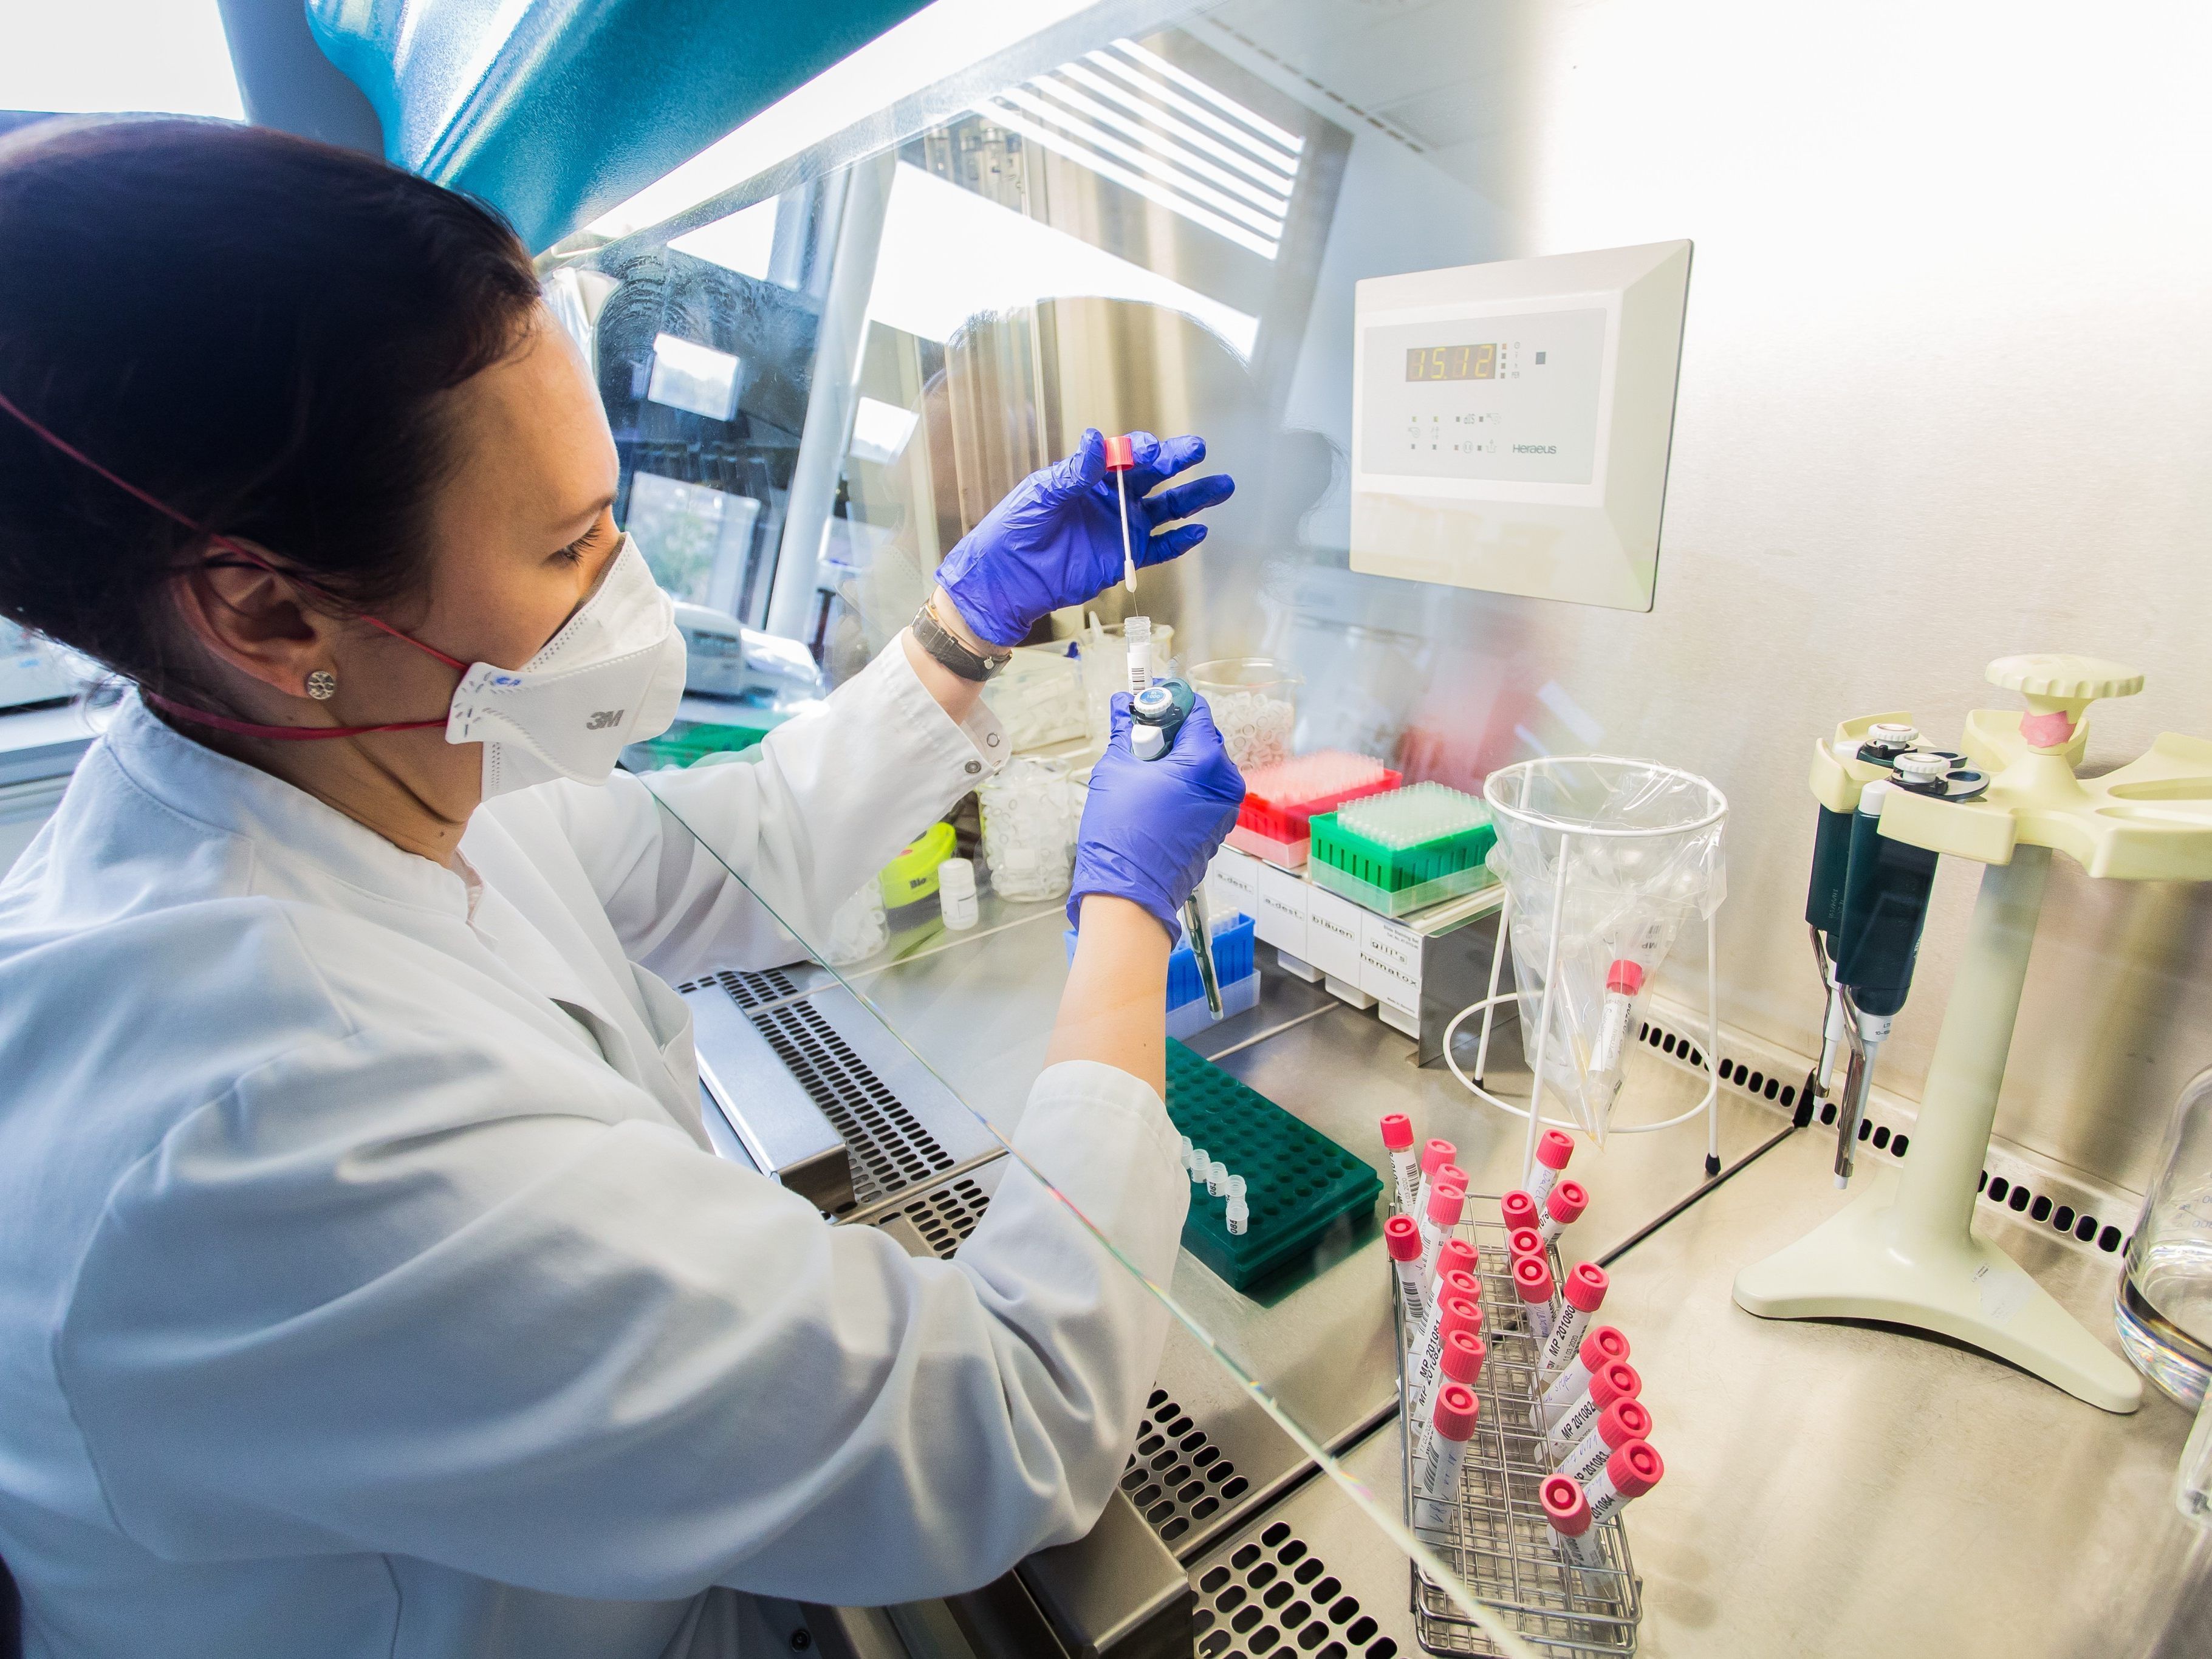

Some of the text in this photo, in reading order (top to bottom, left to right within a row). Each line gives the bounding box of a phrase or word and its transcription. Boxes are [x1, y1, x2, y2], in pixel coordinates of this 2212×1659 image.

[1512, 444, 1557, 454] Heraeus
[586, 709, 625, 730] 3M
[1372, 941, 1405, 963] gill's
[1360, 952, 1417, 987] hematox
[1549, 1338, 1561, 1357] MP
[1556, 1305, 1576, 1341] 201080
[1419, 1359, 1430, 1378] MP
[1419, 1386, 1426, 1407] MP
[1561, 1423, 1573, 1440] MP
[1571, 1401, 1597, 1429] 201082
[1583, 1451, 1610, 1476] 201083
